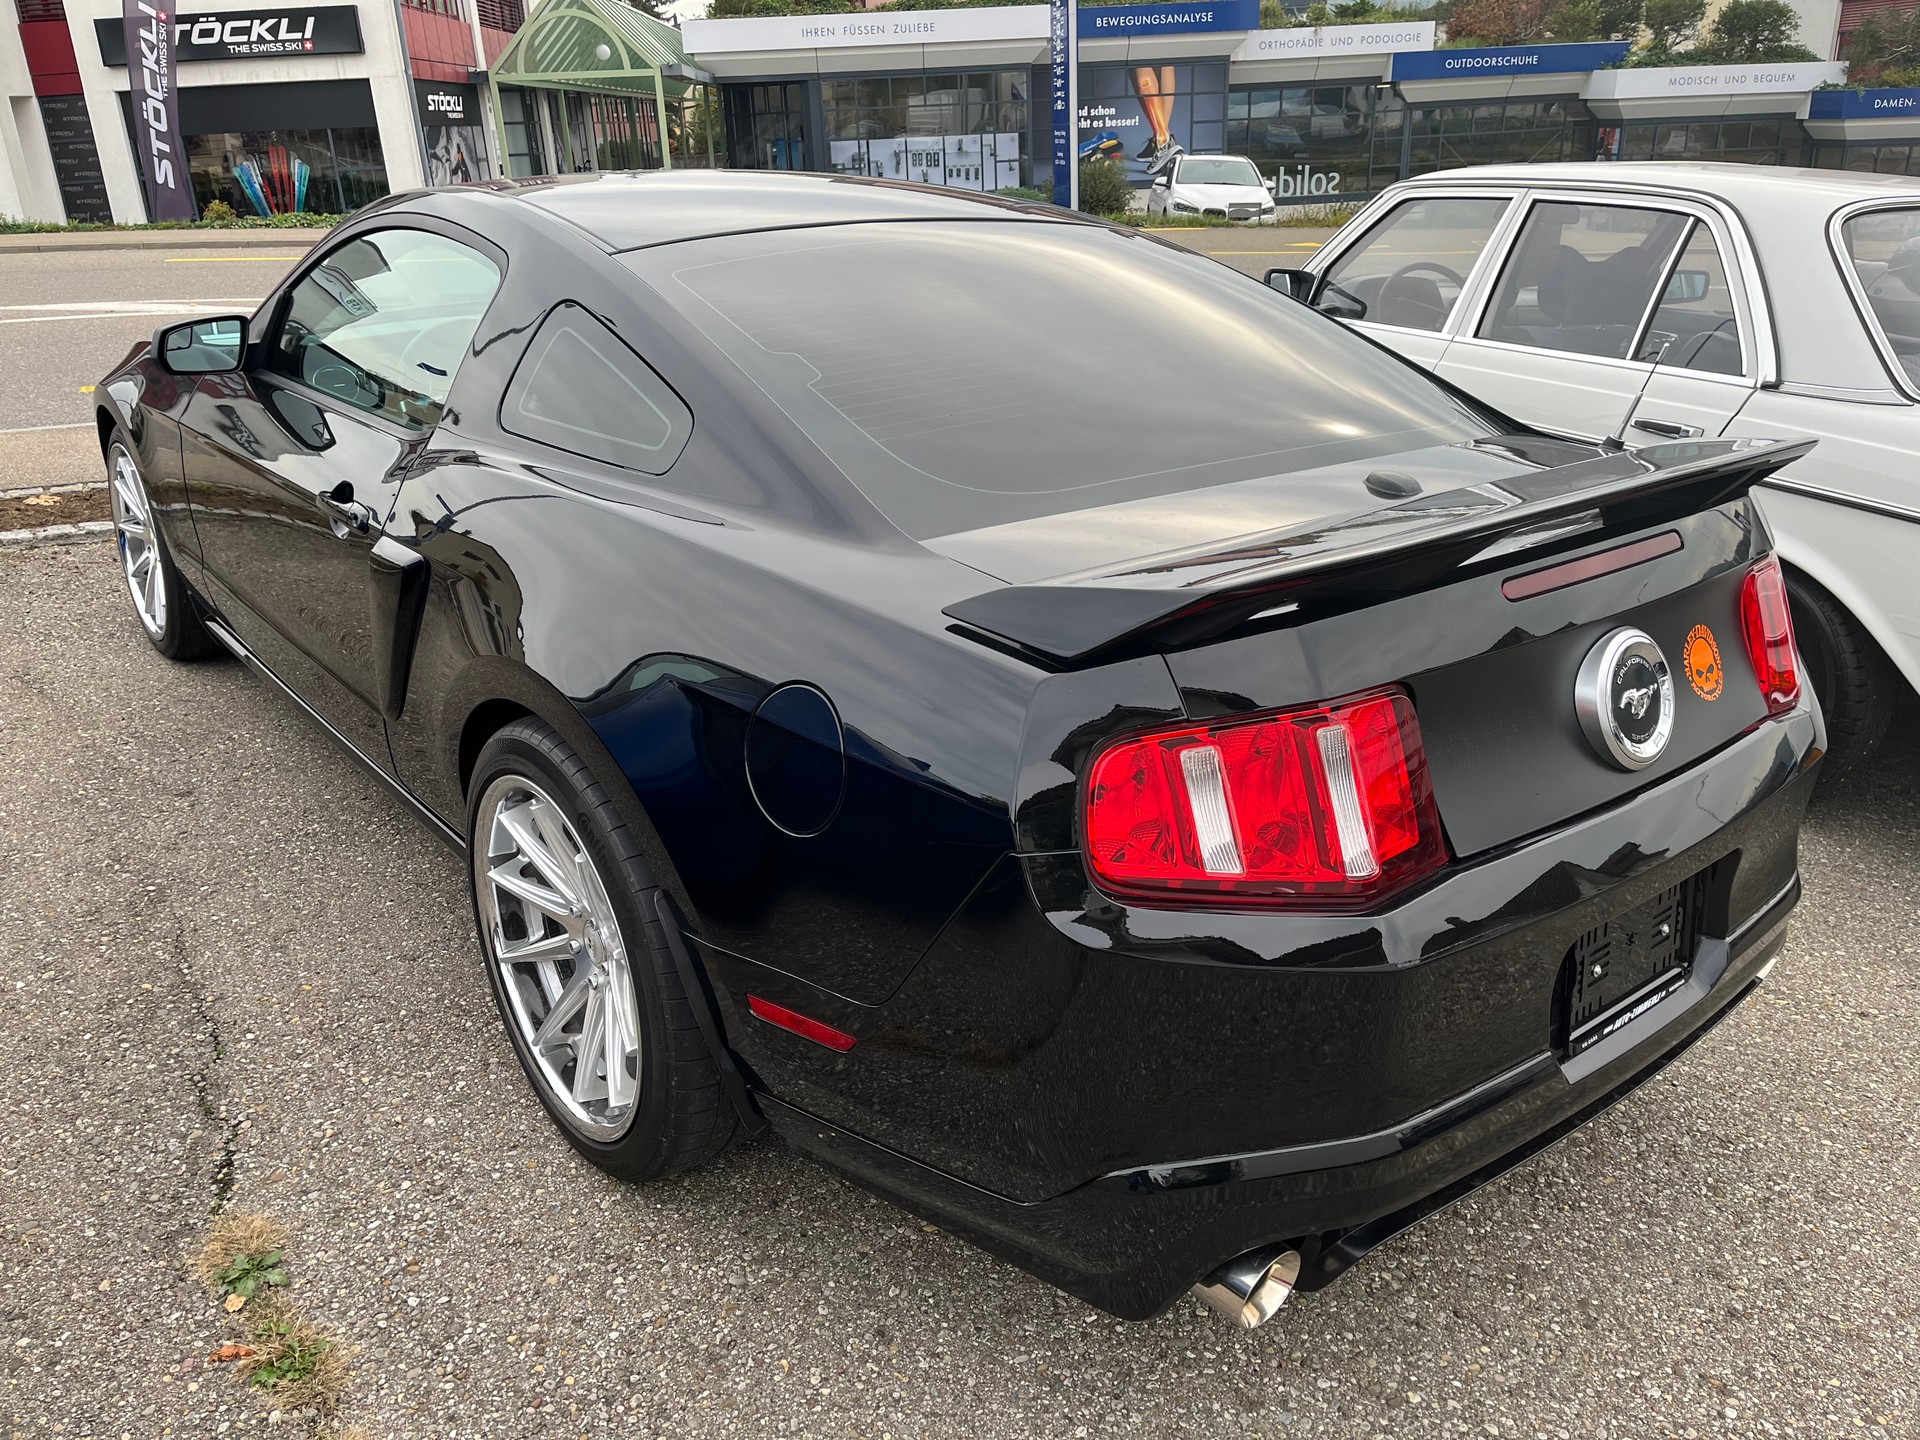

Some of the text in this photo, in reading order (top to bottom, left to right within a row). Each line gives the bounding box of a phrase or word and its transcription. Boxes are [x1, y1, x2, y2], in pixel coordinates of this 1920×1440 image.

[1096, 12, 1213, 27] BEWEGUNGSANALYSE
[175, 16, 315, 46] TÖCKLI
[801, 22, 935, 38] IHREN FÜSSEN ZULIEBE
[227, 42, 302, 54] THE SWISS SKI
[1259, 32, 1421, 50] ORTHOPÄDIE UND PODOLOGIE
[158, 23, 169, 99] THE SWISS SKI
[1445, 55, 1539, 69] OUTDOORSCHUHE
[1668, 73, 1796, 87] MODISCH UND BEQUEM
[138, 1, 175, 190] STÖCKLI
[428, 91, 463, 112] STÖCKLI
[1090, 105, 1116, 116] schon
[1874, 98, 1917, 109] DAMEN-
[1093, 119, 1103, 128] es
[1105, 116, 1139, 128] besser!
